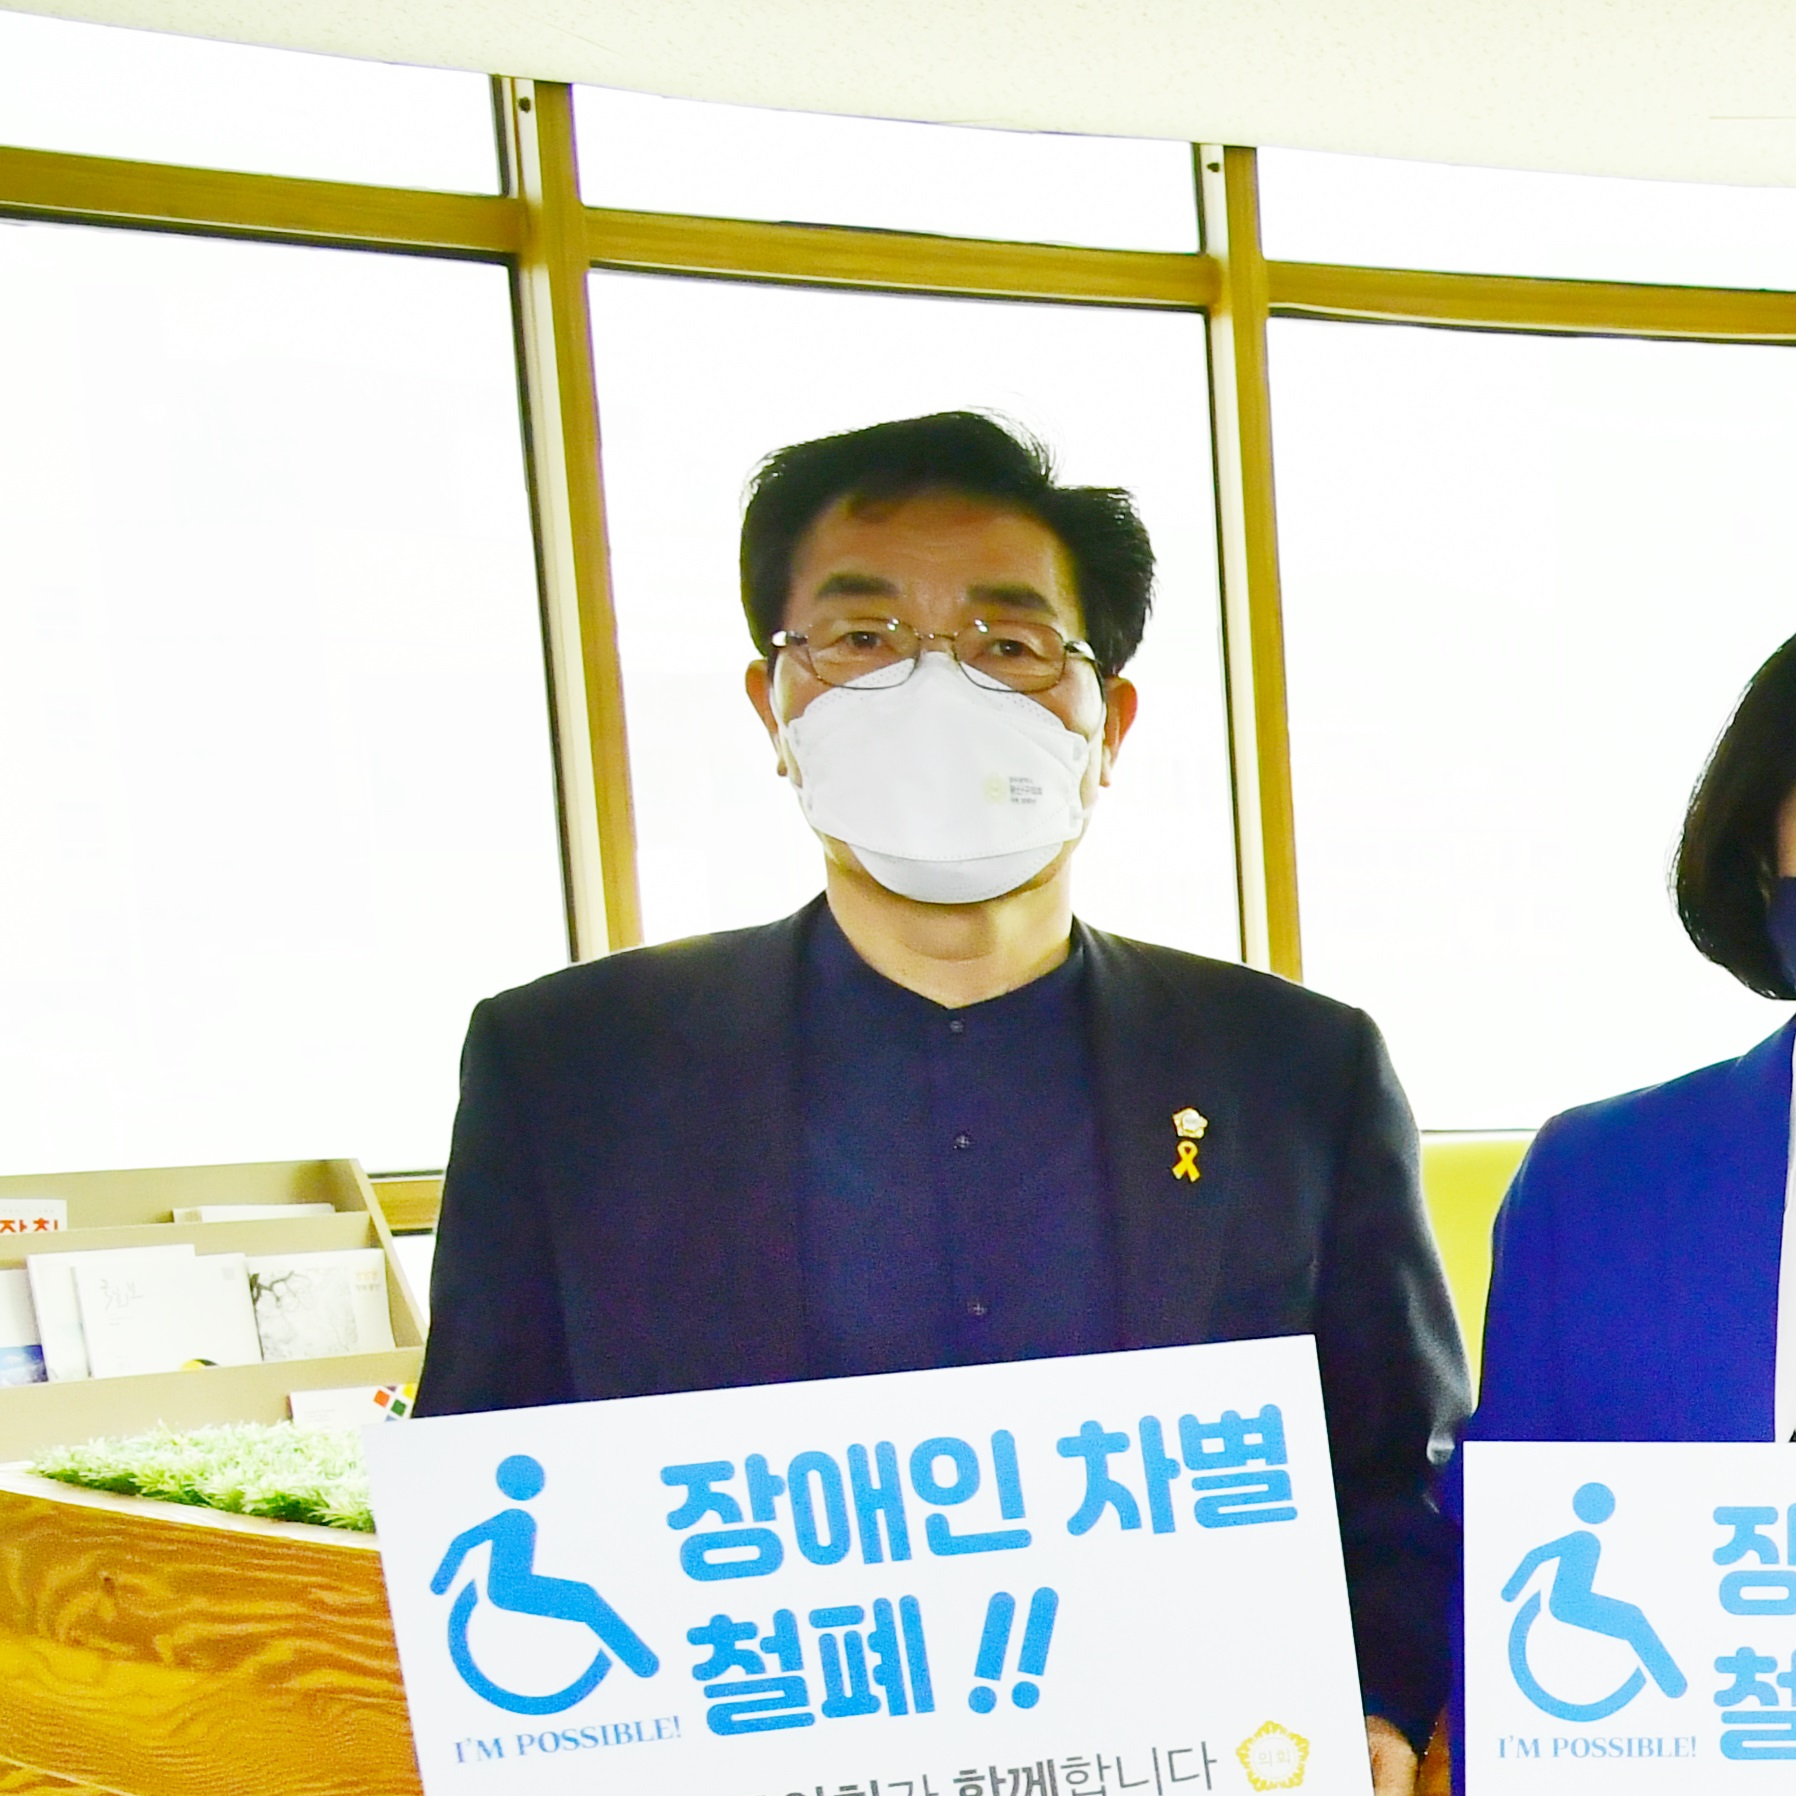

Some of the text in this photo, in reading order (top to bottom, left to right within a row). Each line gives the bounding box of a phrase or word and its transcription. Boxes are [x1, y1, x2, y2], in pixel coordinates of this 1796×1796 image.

[660, 1403, 1298, 1582] 장애인 차별
[686, 1586, 1059, 1736] 철폐 !!
[454, 1714, 681, 1764] I'M POSSIBLE!
[1498, 1734, 1697, 1760] I'M POSSIBLE!
